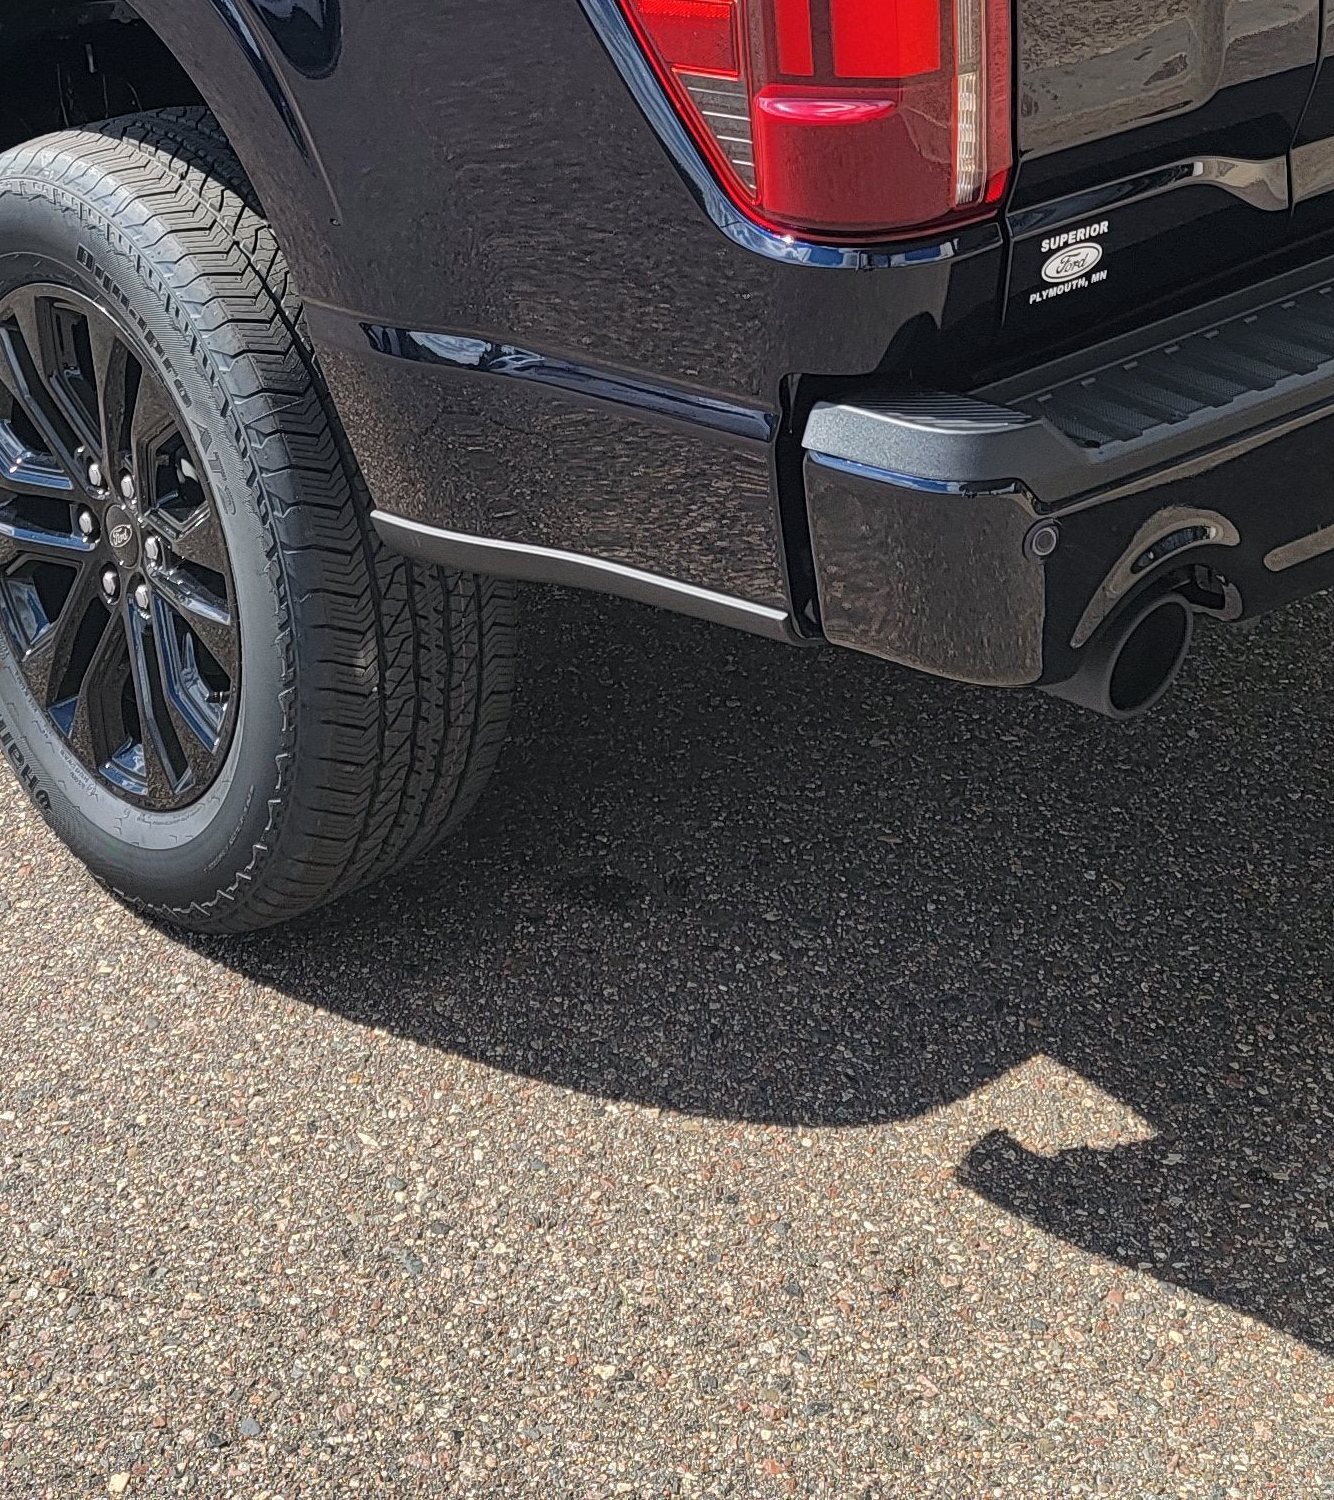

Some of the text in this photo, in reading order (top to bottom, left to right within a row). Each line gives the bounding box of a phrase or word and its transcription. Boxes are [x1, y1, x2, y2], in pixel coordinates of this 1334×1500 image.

[1040, 221, 1109, 252] SUPERIOR
[1056, 252, 1089, 274] Ford
[1029, 270, 1108, 304] PLYMOUTH, MN
